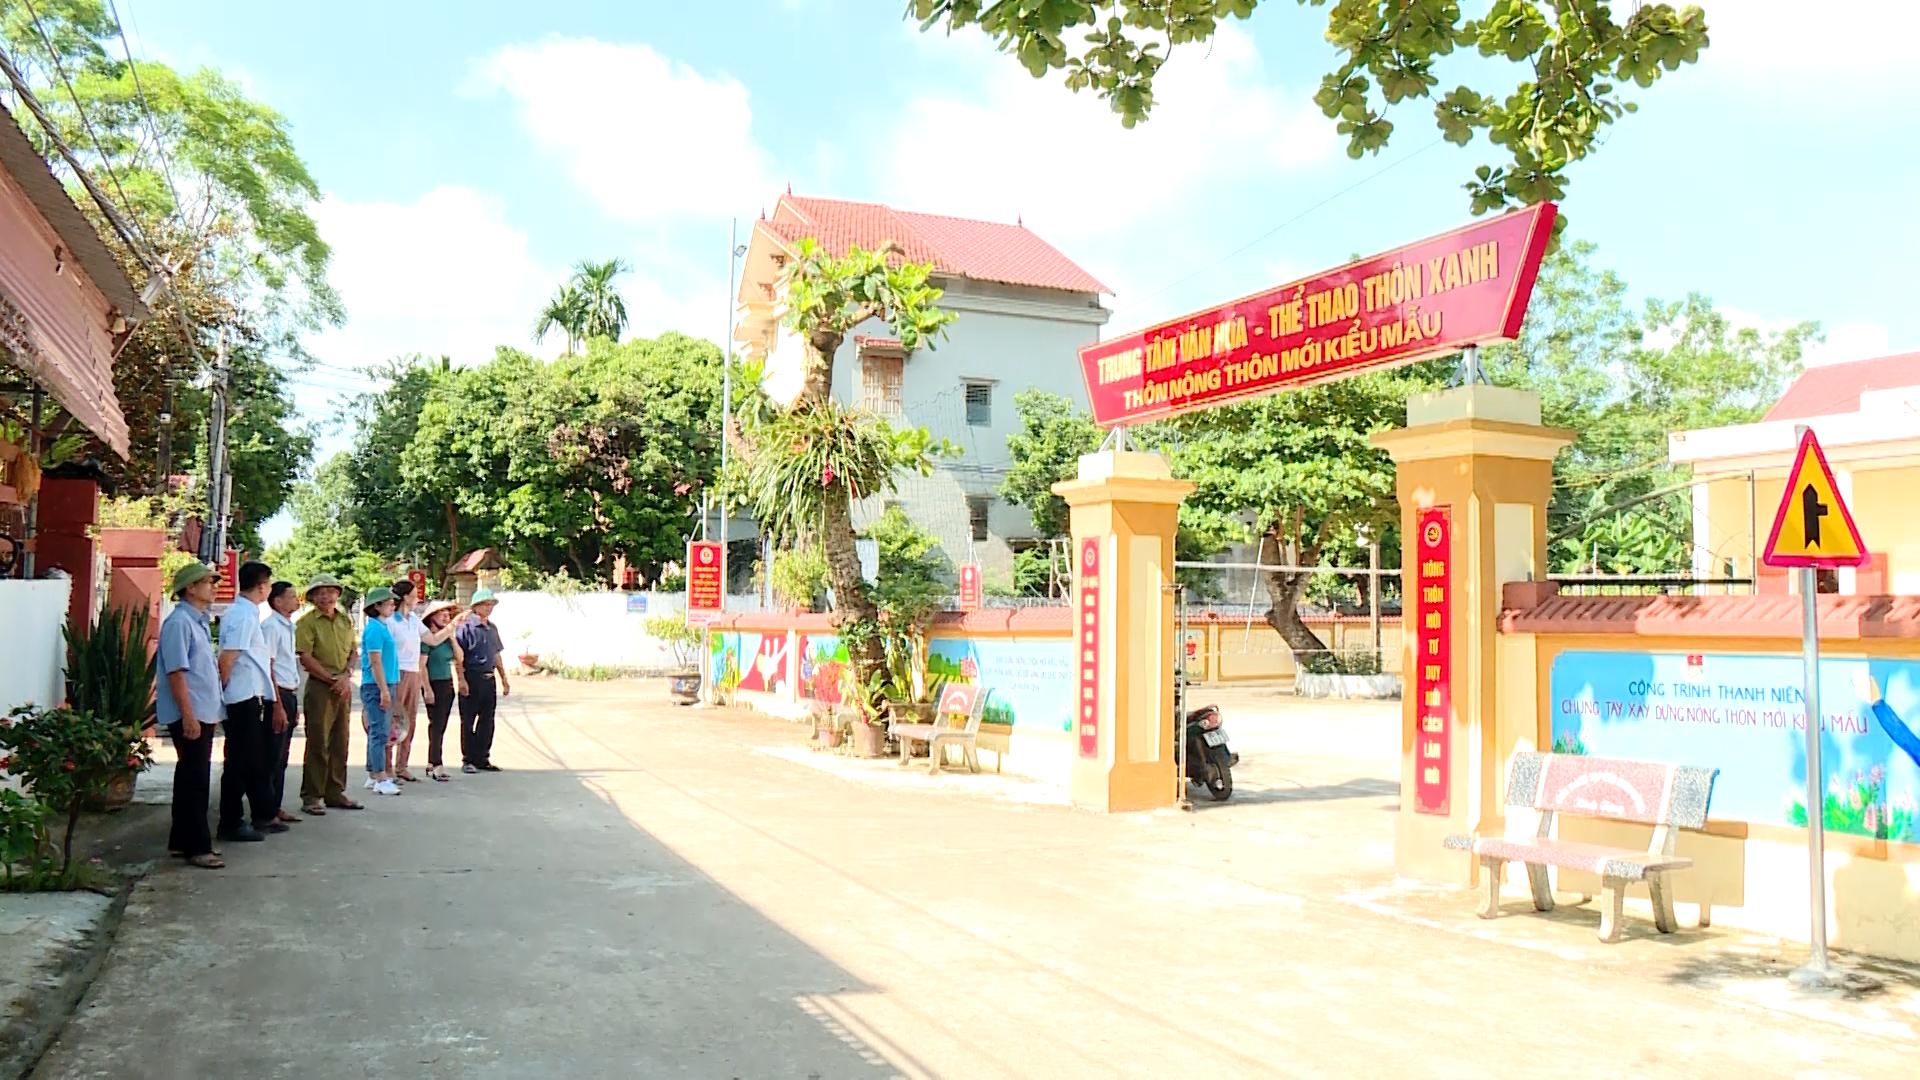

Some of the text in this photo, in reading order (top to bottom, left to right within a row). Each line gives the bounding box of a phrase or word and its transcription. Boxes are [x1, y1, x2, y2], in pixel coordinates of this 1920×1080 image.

[1097, 348, 1142, 385] TRUNG
[1180, 324, 1212, 362] VĂN
[1268, 285, 1304, 339] THỂ
[1307, 282, 1361, 329] THAO
[1363, 262, 1423, 313] THÔN
[1428, 241, 1500, 295] XANH
[1123, 305, 1444, 410] THÔN NÔNG THÔN MỚI KIỂU MẪU
[1605, 701, 1623, 718] TAY
[1628, 678, 1665, 696] CÔNG
[1718, 684, 1765, 701] THANH
